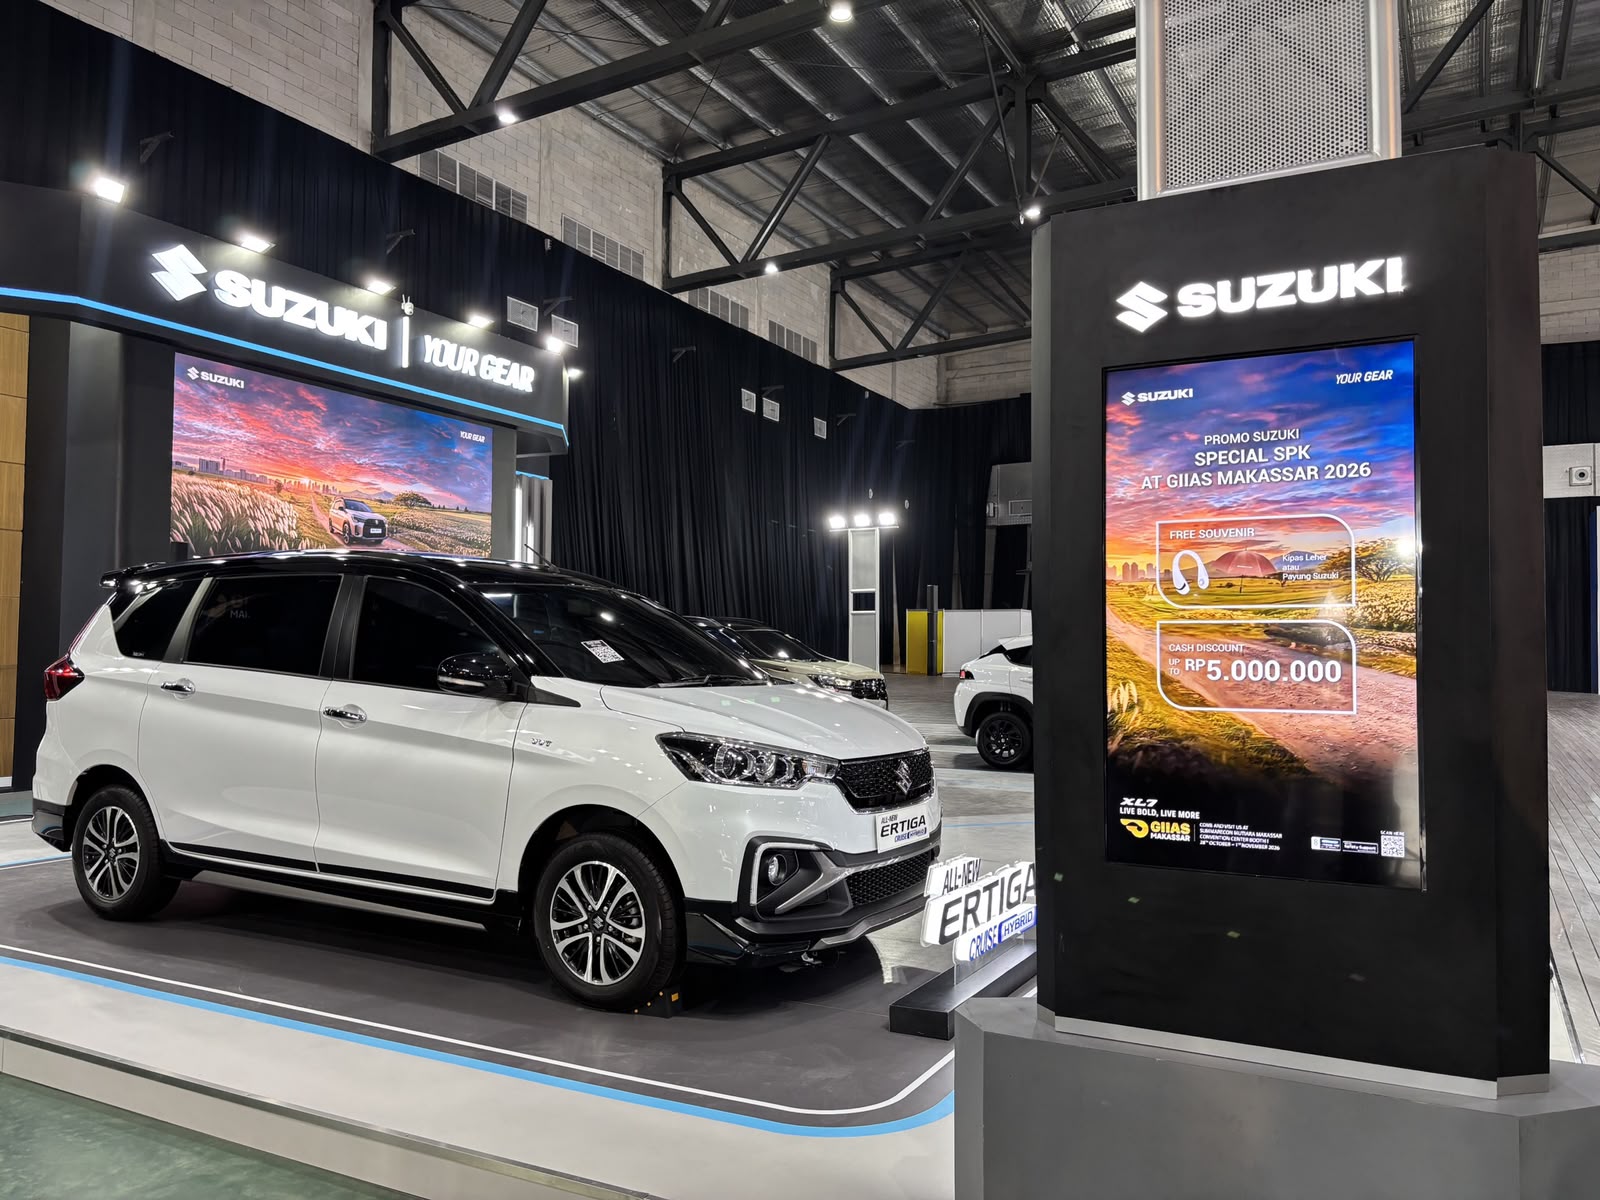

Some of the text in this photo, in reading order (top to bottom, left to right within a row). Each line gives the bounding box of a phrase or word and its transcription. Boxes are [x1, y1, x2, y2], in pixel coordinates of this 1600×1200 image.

[1177, 257, 1403, 318] SUZUKI
[214, 269, 388, 351] SUZUKI
[423, 334, 535, 393] YOUR GEAR
[200, 371, 245, 389] SUZUKI
[1335, 369, 1394, 384] YOUR GEAR
[1137, 388, 1194, 402] SUZUKI
[460, 430, 486, 443] YOUR GEAR
[1204, 428, 1300, 446] PROMO SUZUKI
[1194, 444, 1311, 467] SPECIAL SPK
[1141, 462, 1372, 490] AT GIIAS MAKASSAR 2026
[1169, 527, 1255, 540] FREE SOUVENIR
[1282, 553, 1327, 563] Kipas Leher
[1282, 571, 1339, 581] Payung Suzuki
[1168, 643, 1244, 653] CASH DISCOUNT
[1168, 658, 1180, 666] UP
[1168, 667, 1180, 675] TO
[1120, 797, 1158, 807] XL7
[1120, 807, 1200, 819] LIVE BOLD, LIVE MORE
[880, 815, 927, 838] ERTIGA
[1150, 821, 1191, 835] GIIAS
[1150, 833, 1191, 842] MAKASSAR
[942, 857, 982, 896] ALL-NEW
[939, 863, 1036, 945] ERTIGA
[969, 910, 1033, 962] CRUISE HYBRID
